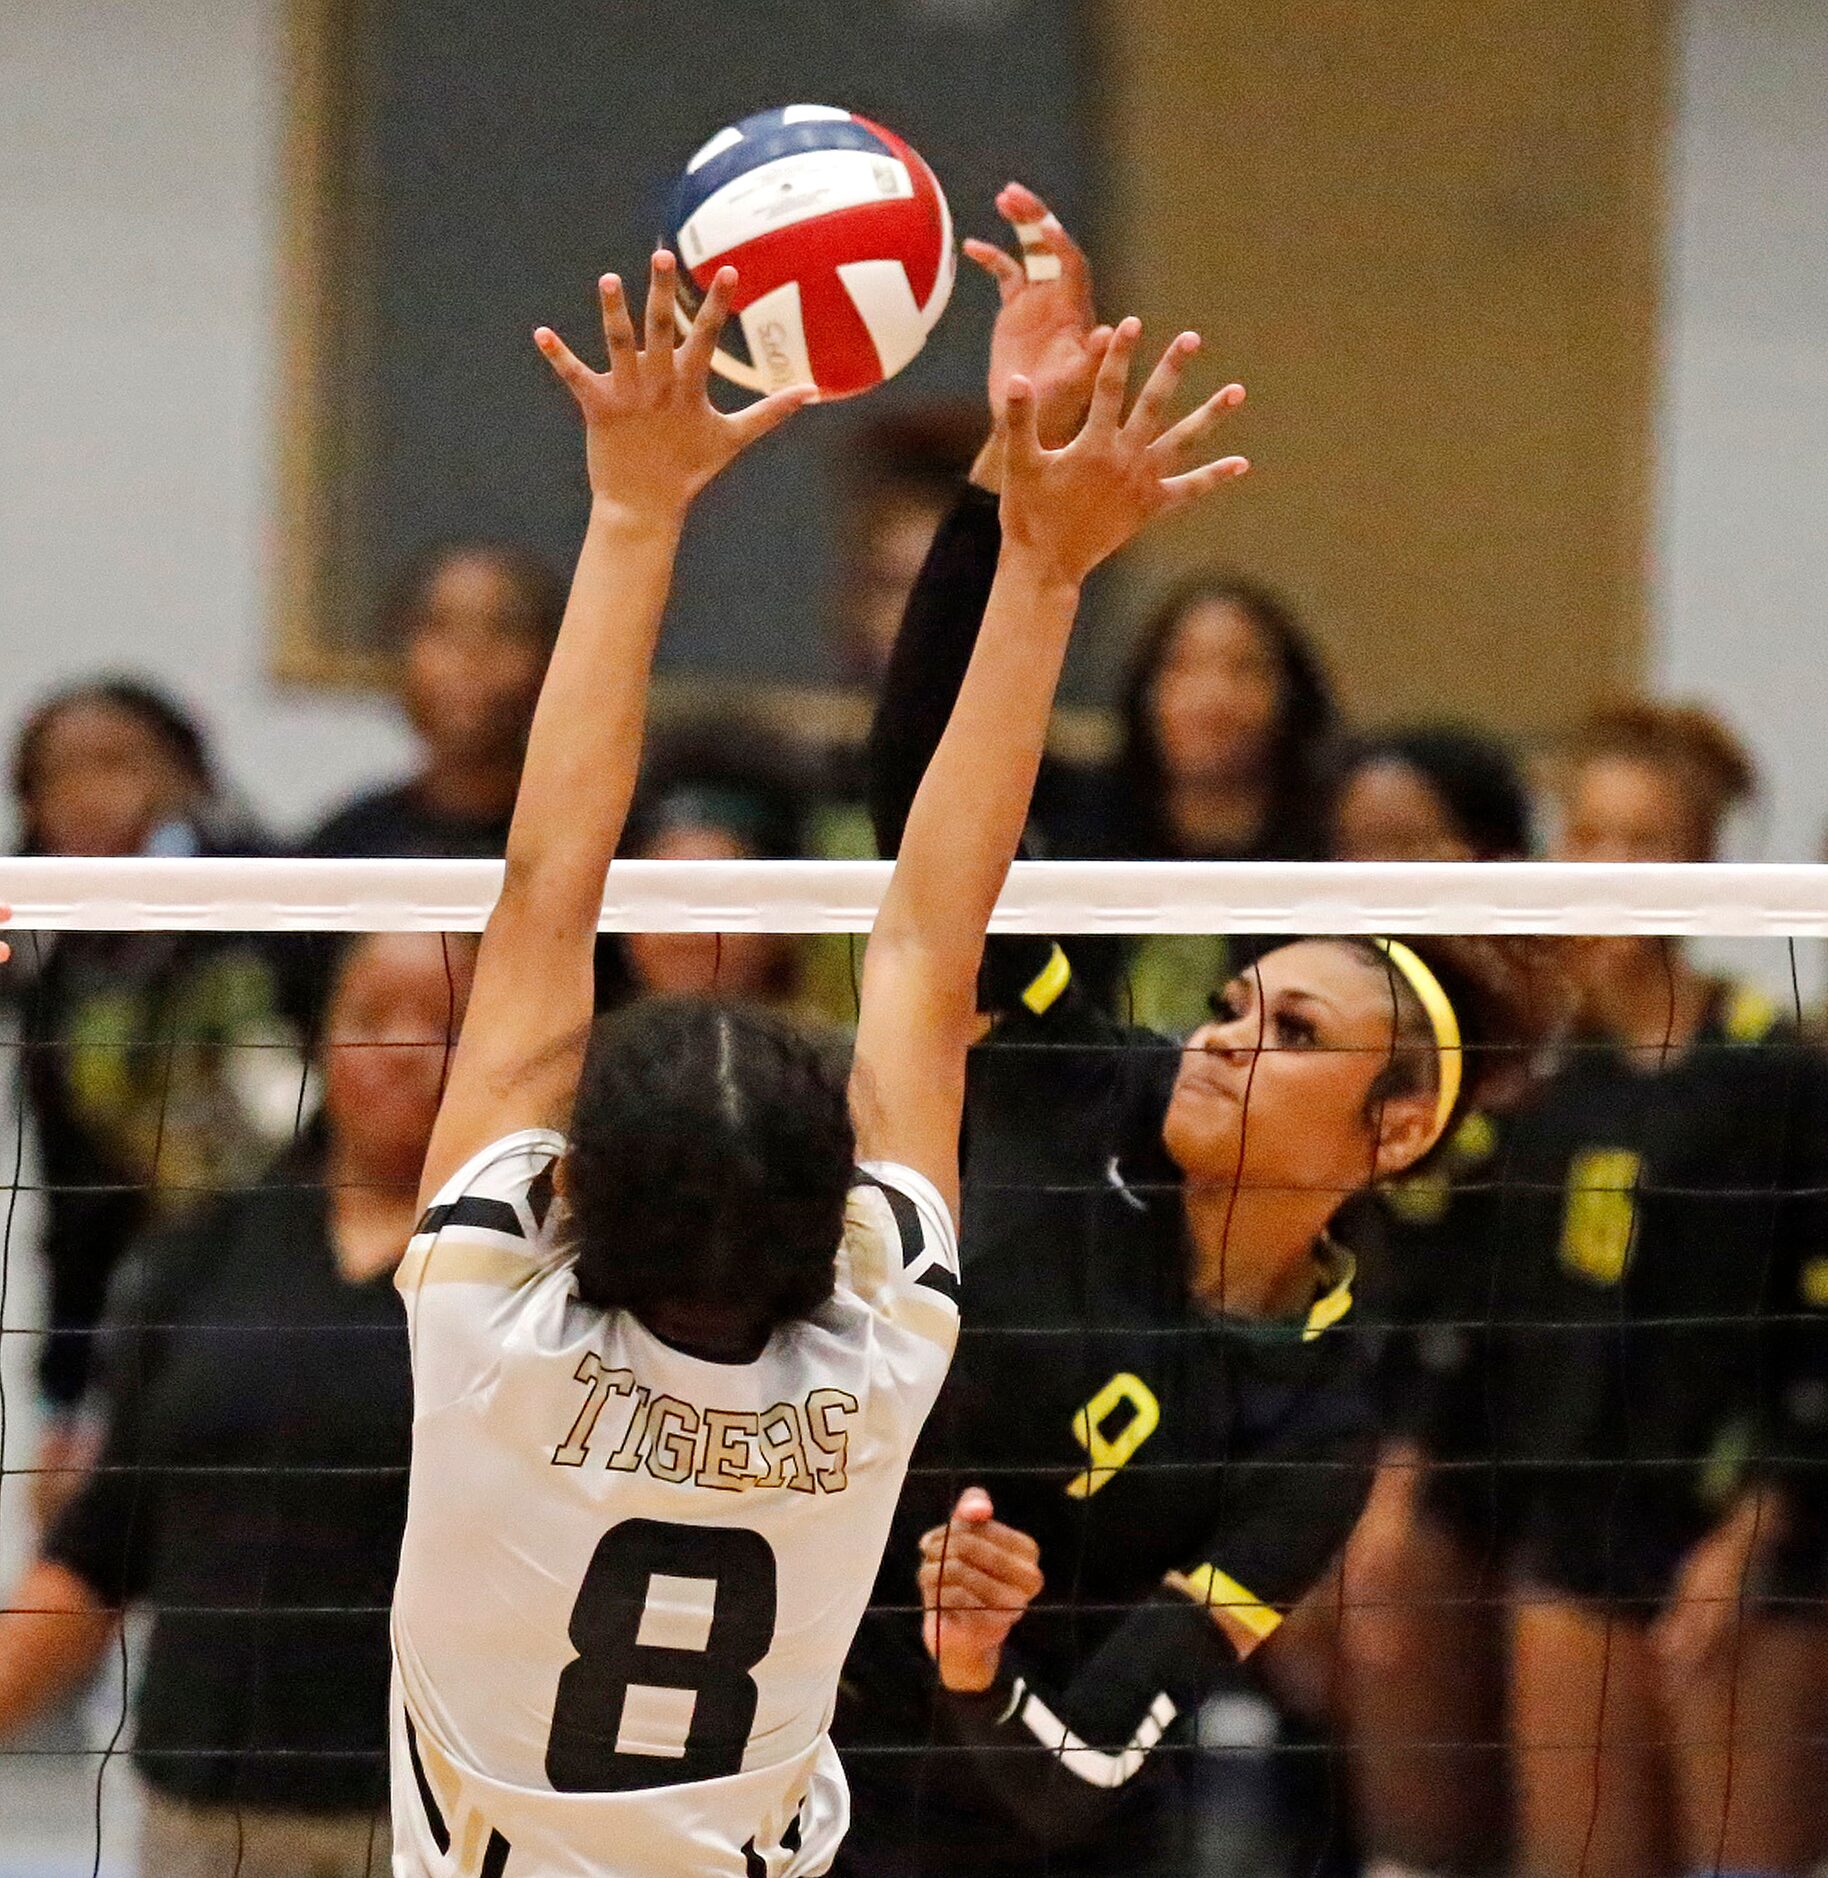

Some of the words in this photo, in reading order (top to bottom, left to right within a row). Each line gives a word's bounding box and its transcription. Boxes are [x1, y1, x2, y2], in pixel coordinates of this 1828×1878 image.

[551, 1351, 859, 1494] TIGERS
[1065, 1371, 1160, 1499] 9
[545, 1517, 777, 1793] 8
